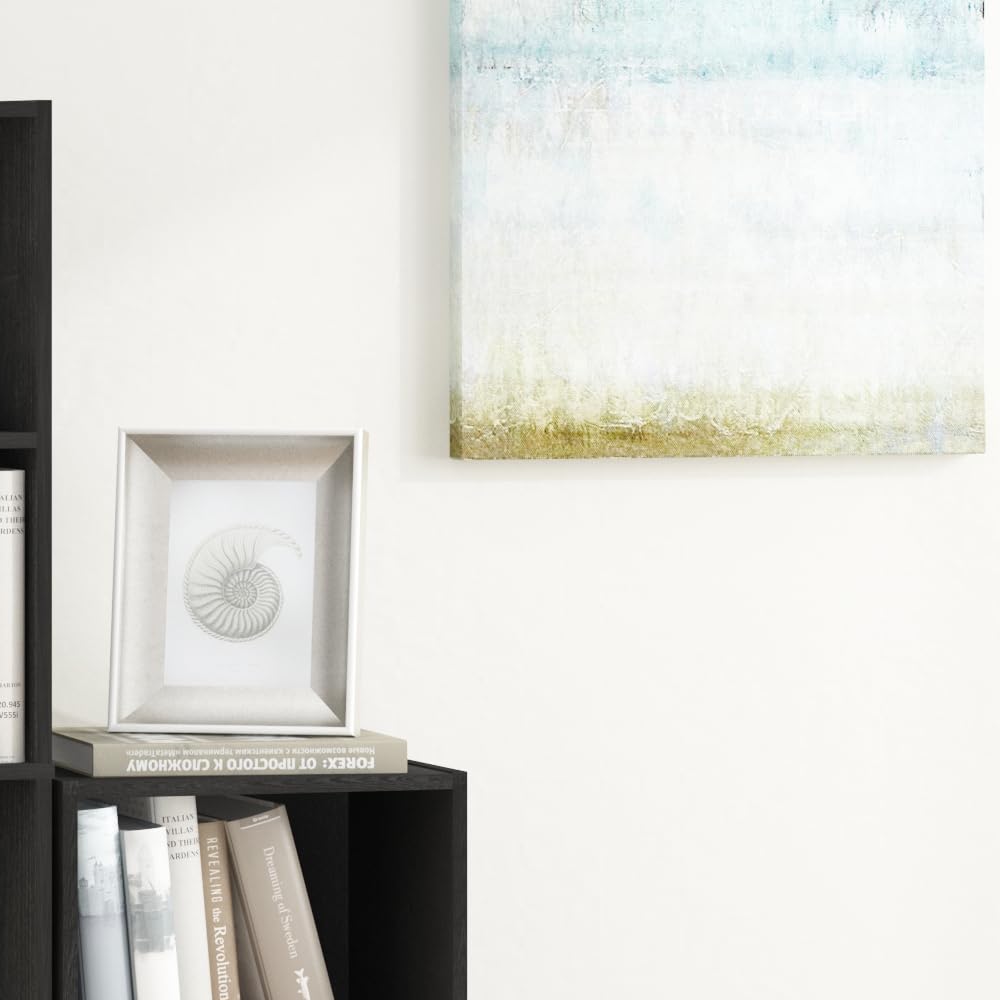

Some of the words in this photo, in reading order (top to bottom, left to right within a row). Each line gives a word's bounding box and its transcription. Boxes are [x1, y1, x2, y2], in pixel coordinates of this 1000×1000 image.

[182, 748, 233, 757] терминалом
[234, 747, 284, 756] клиентским
[291, 747, 347, 756] возможности
[348, 747, 375, 755] Новые
[126, 757, 211, 772] СЛОЖНОМУ
[213, 757, 223, 771] К
[226, 756, 296, 771] ПРОСТОГО
[298, 756, 317, 770] ОТ
[323, 756, 375, 770] FOREX:
[162, 814, 194, 823] ITALIAN
[169, 849, 200, 860] ARDENS
[206, 837, 223, 903] REVEALING
[263, 845, 284, 905] Dreaming
[280, 915, 299, 959] Sweden
[211, 907, 222, 923] the
[212, 926, 231, 1000] Revolution
